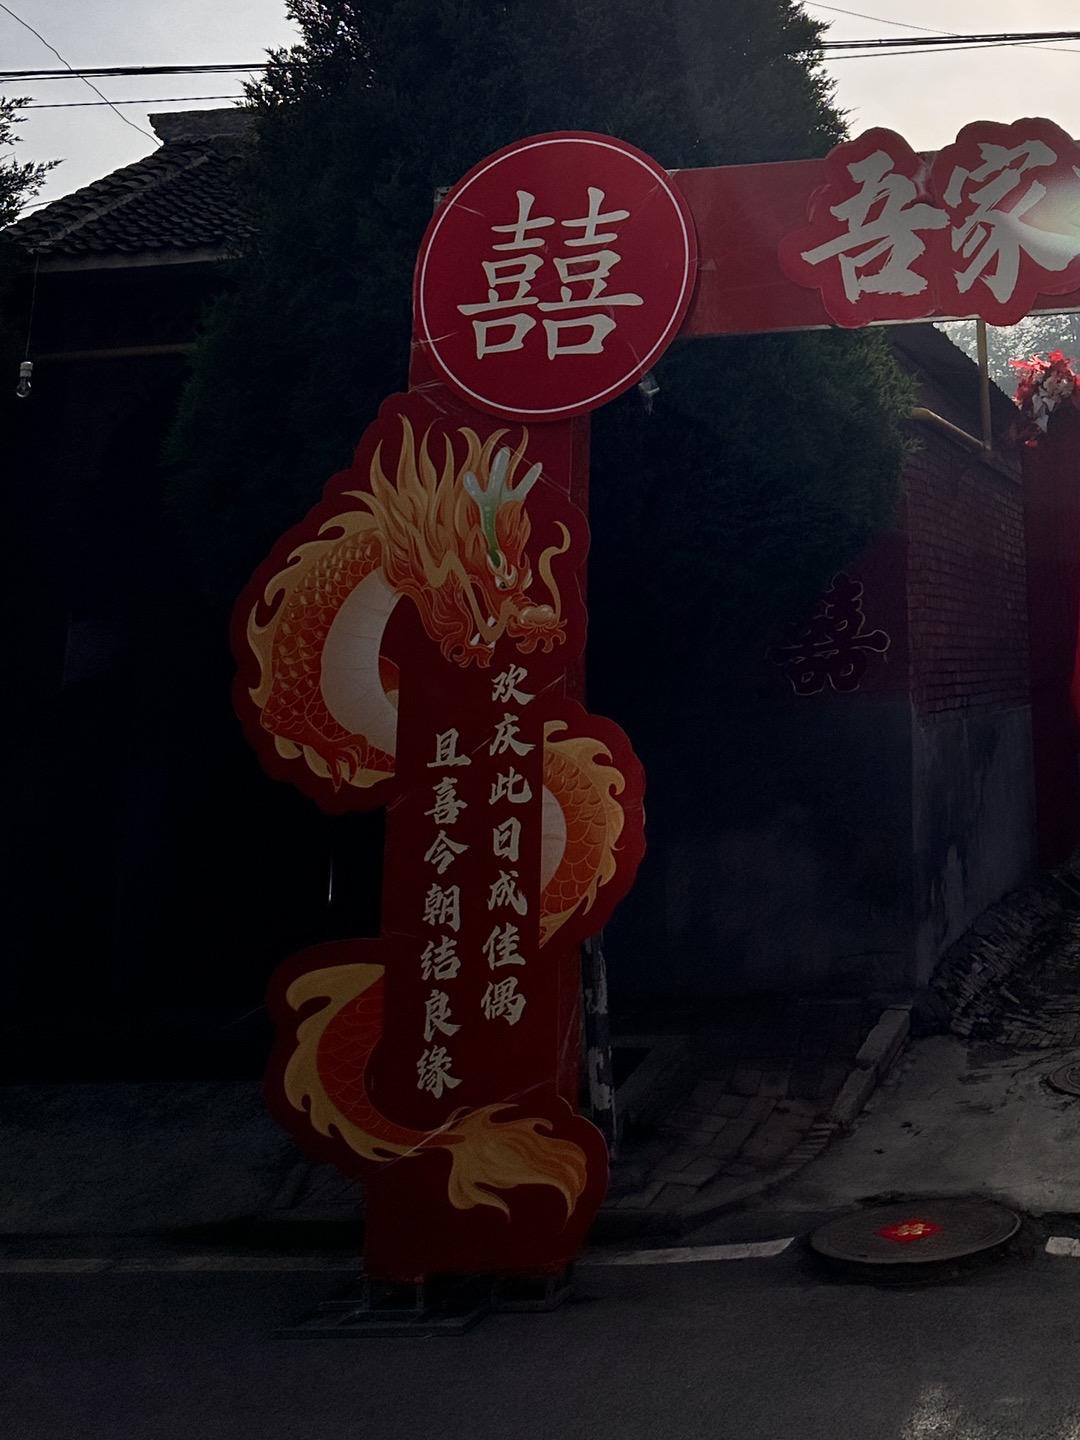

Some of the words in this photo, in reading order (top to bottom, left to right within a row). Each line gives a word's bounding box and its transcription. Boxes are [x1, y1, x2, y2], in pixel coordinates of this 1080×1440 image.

[456, 186, 643, 362] 囍
[415, 728, 473, 1098] 且喜今朝结良缘
[480, 663, 537, 1025] 欢庆此日成佳偶
